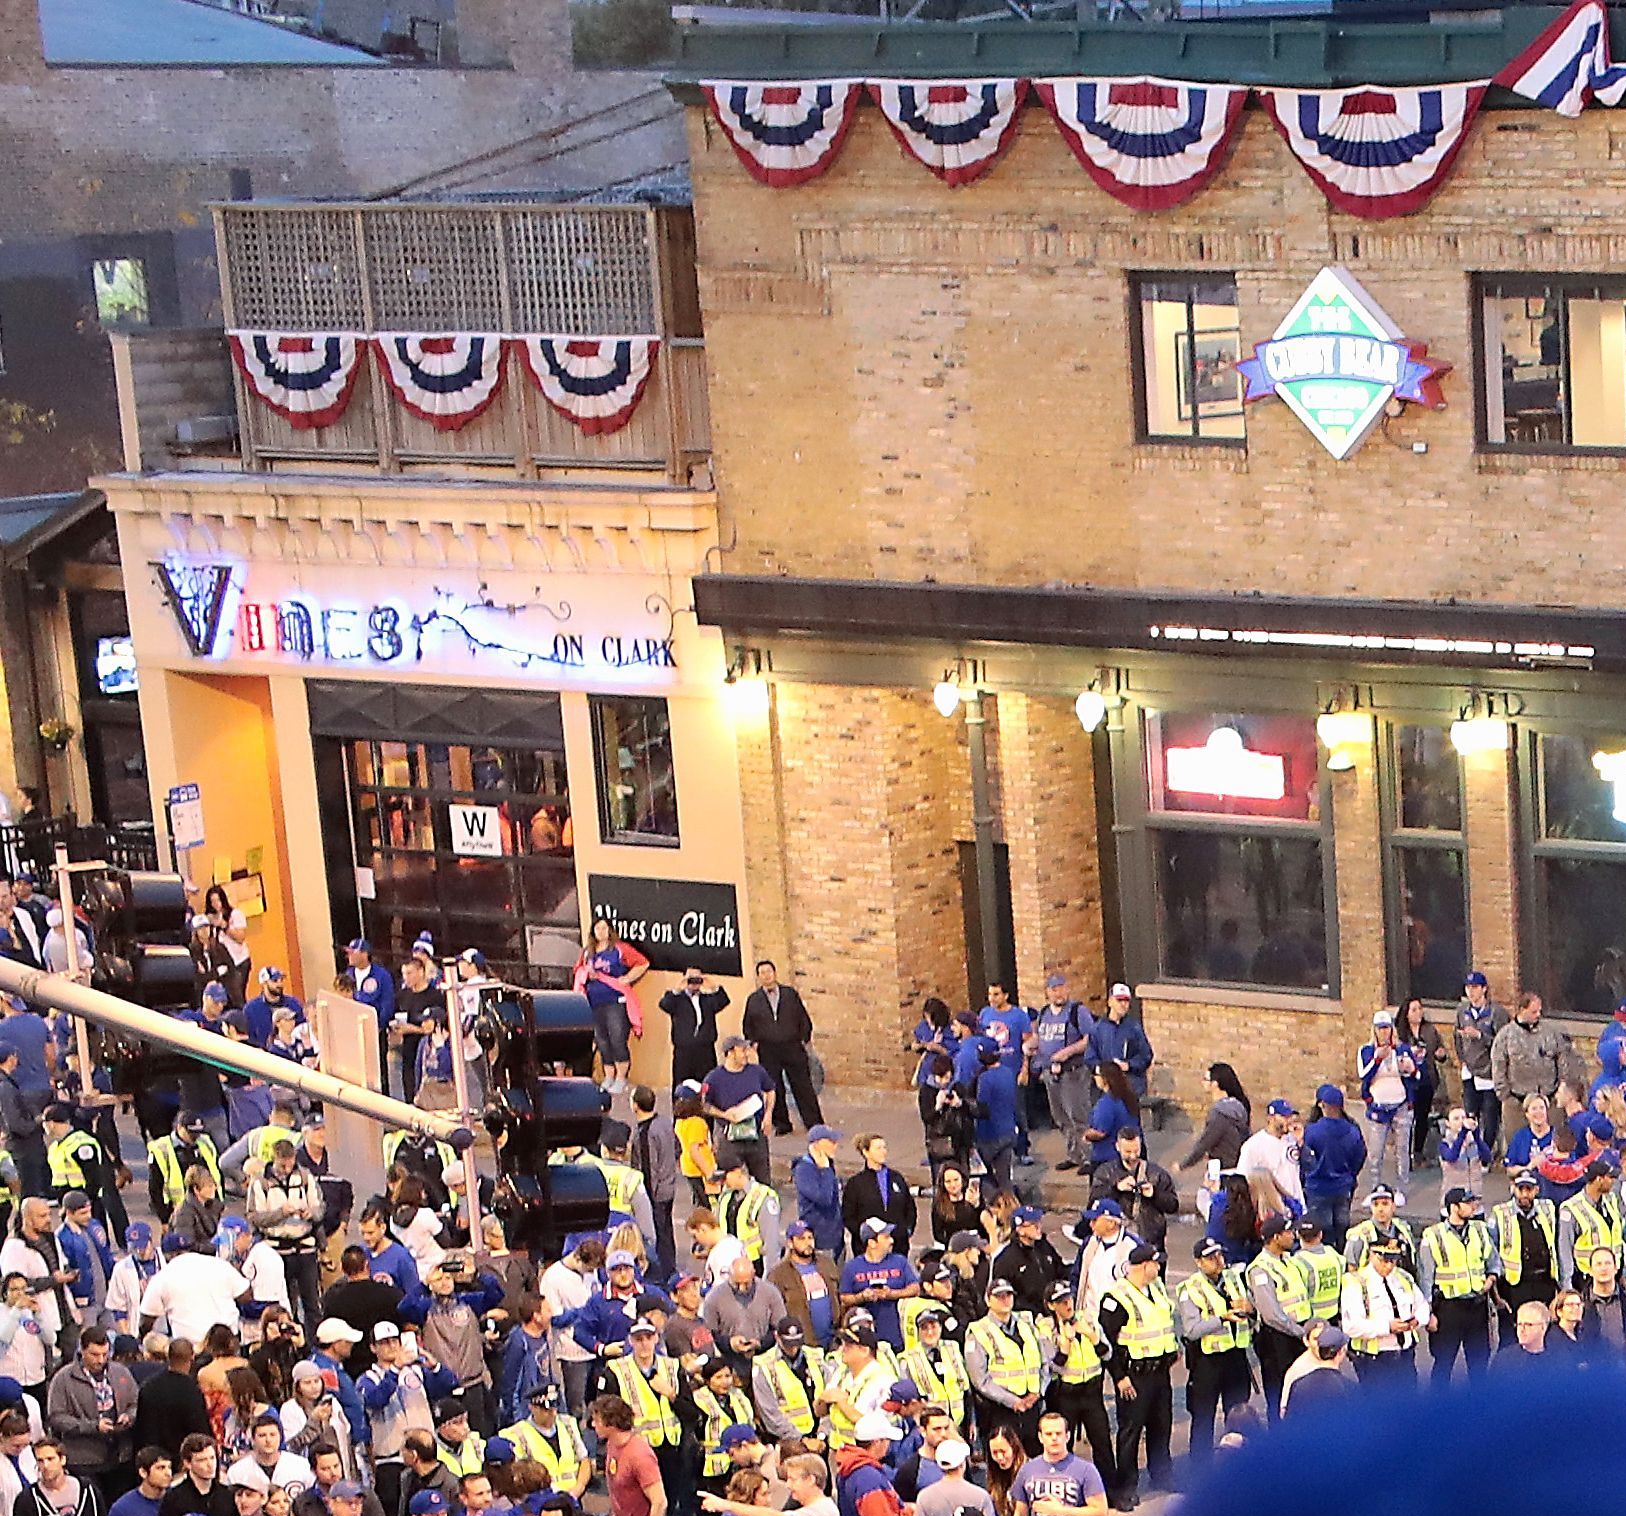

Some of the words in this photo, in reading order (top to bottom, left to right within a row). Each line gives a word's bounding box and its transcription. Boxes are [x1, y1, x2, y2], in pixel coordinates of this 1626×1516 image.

[552, 635, 584, 662] ON
[601, 636, 678, 667] CLARK
[461, 810, 487, 837] W
[651, 921, 673, 943] on
[679, 910, 736, 948] Clark
